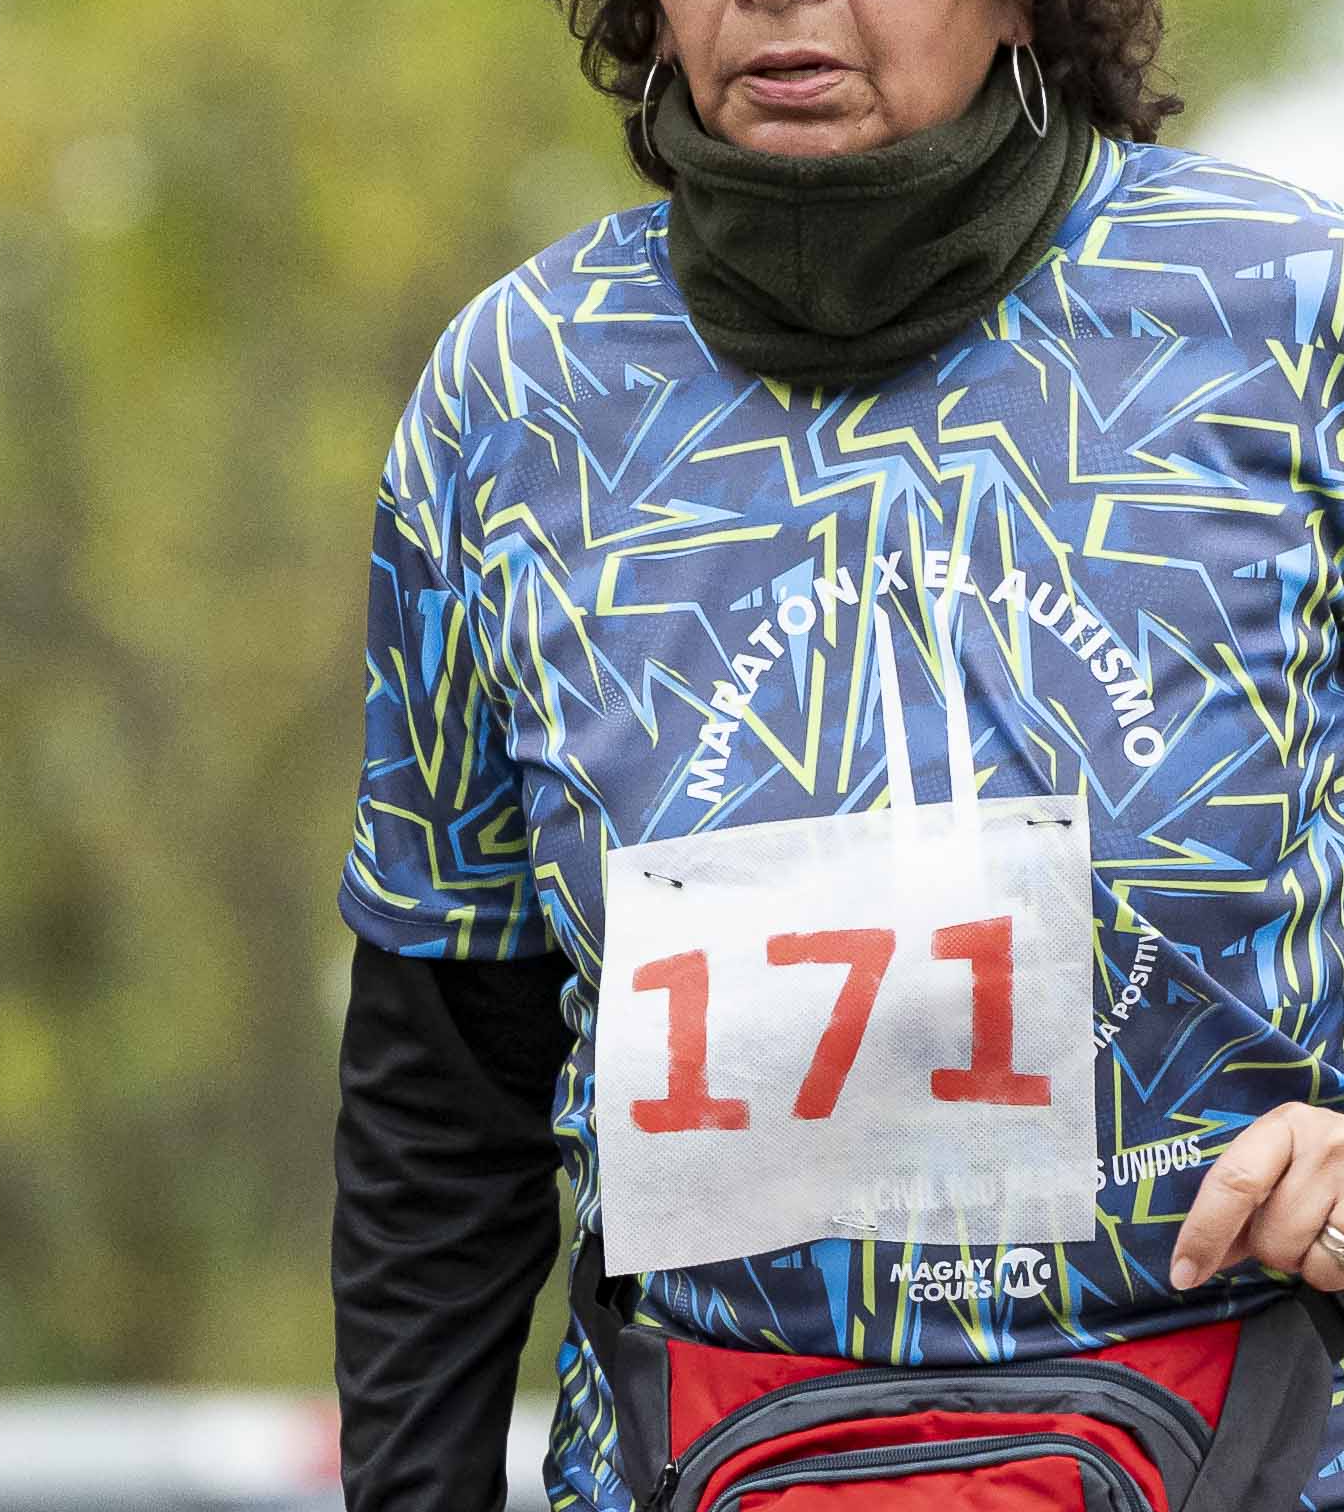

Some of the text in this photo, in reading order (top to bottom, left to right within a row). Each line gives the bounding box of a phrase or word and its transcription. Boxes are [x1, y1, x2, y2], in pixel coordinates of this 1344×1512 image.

[687, 550, 1164, 803] MARATÓN X EL AUTISMO
[629, 916, 1052, 1134] 171
[1112, 1135, 1202, 1186] UNIDOS
[890, 1257, 993, 1284] MAGNY
[908, 1280, 993, 1302] COURS
